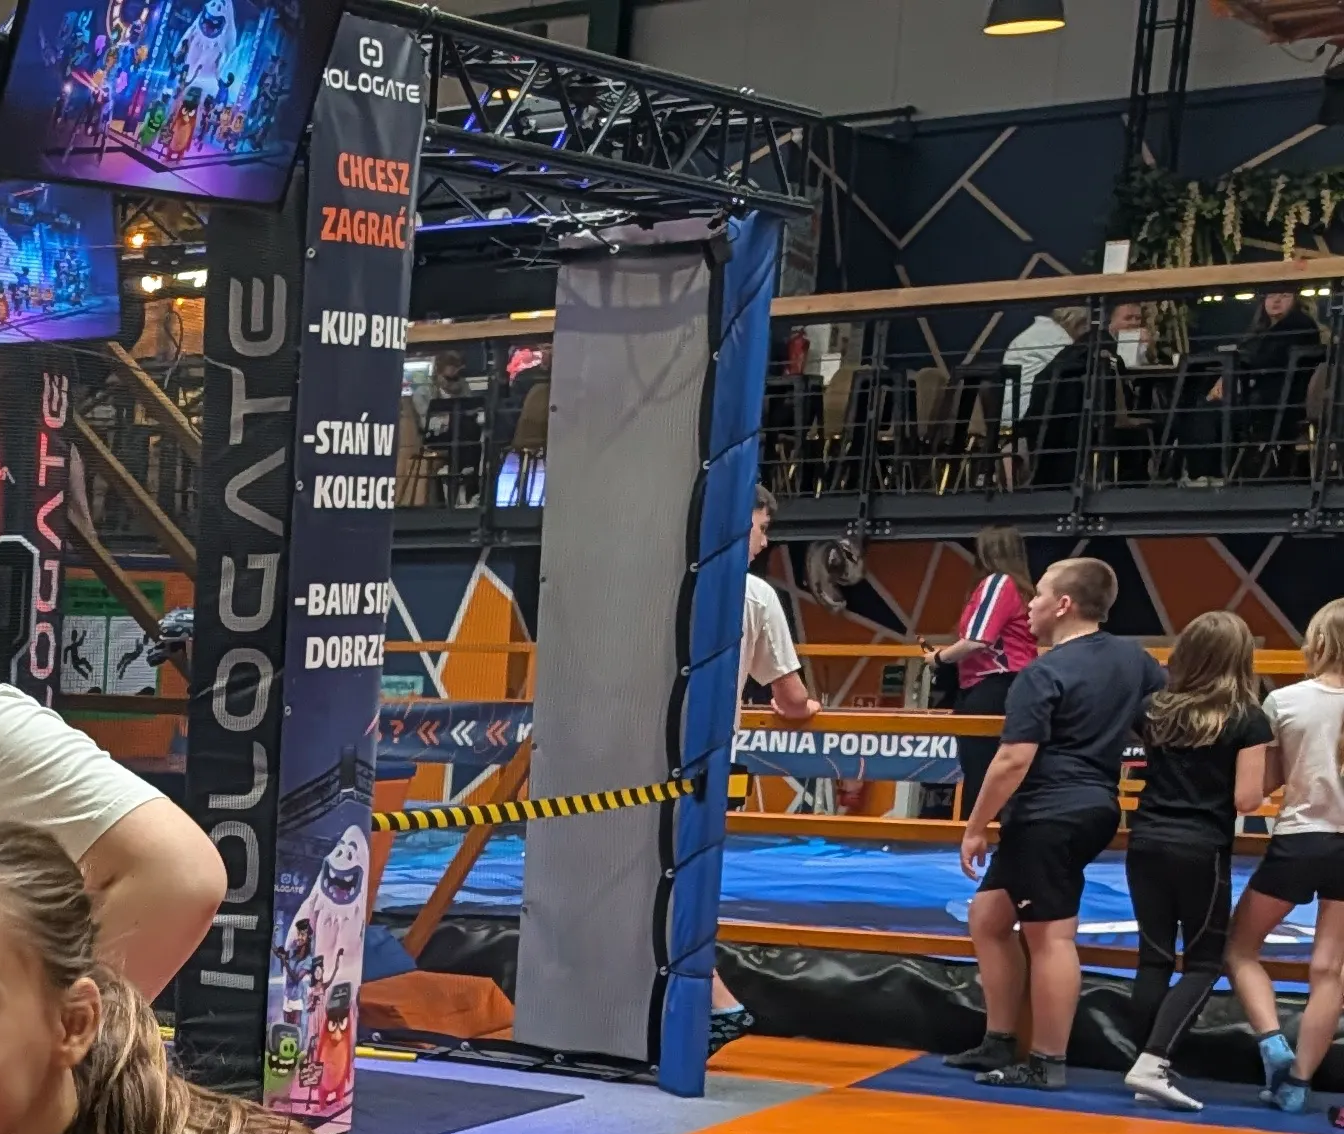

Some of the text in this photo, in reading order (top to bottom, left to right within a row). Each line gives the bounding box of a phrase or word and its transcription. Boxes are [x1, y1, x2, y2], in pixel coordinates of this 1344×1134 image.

[337, 151, 410, 196] CHCESZ
[320, 206, 407, 250] ZAGRAĆ
[309, 309, 409, 351] -KUP BILE
[373, 423, 395, 457] W
[313, 474, 396, 510] KOLEJCE
[29, 372, 69, 708] OGATE
[199, 274, 292, 991] HOLOGATE
[735, 729, 958, 759] ZANIA PODUSZKI
